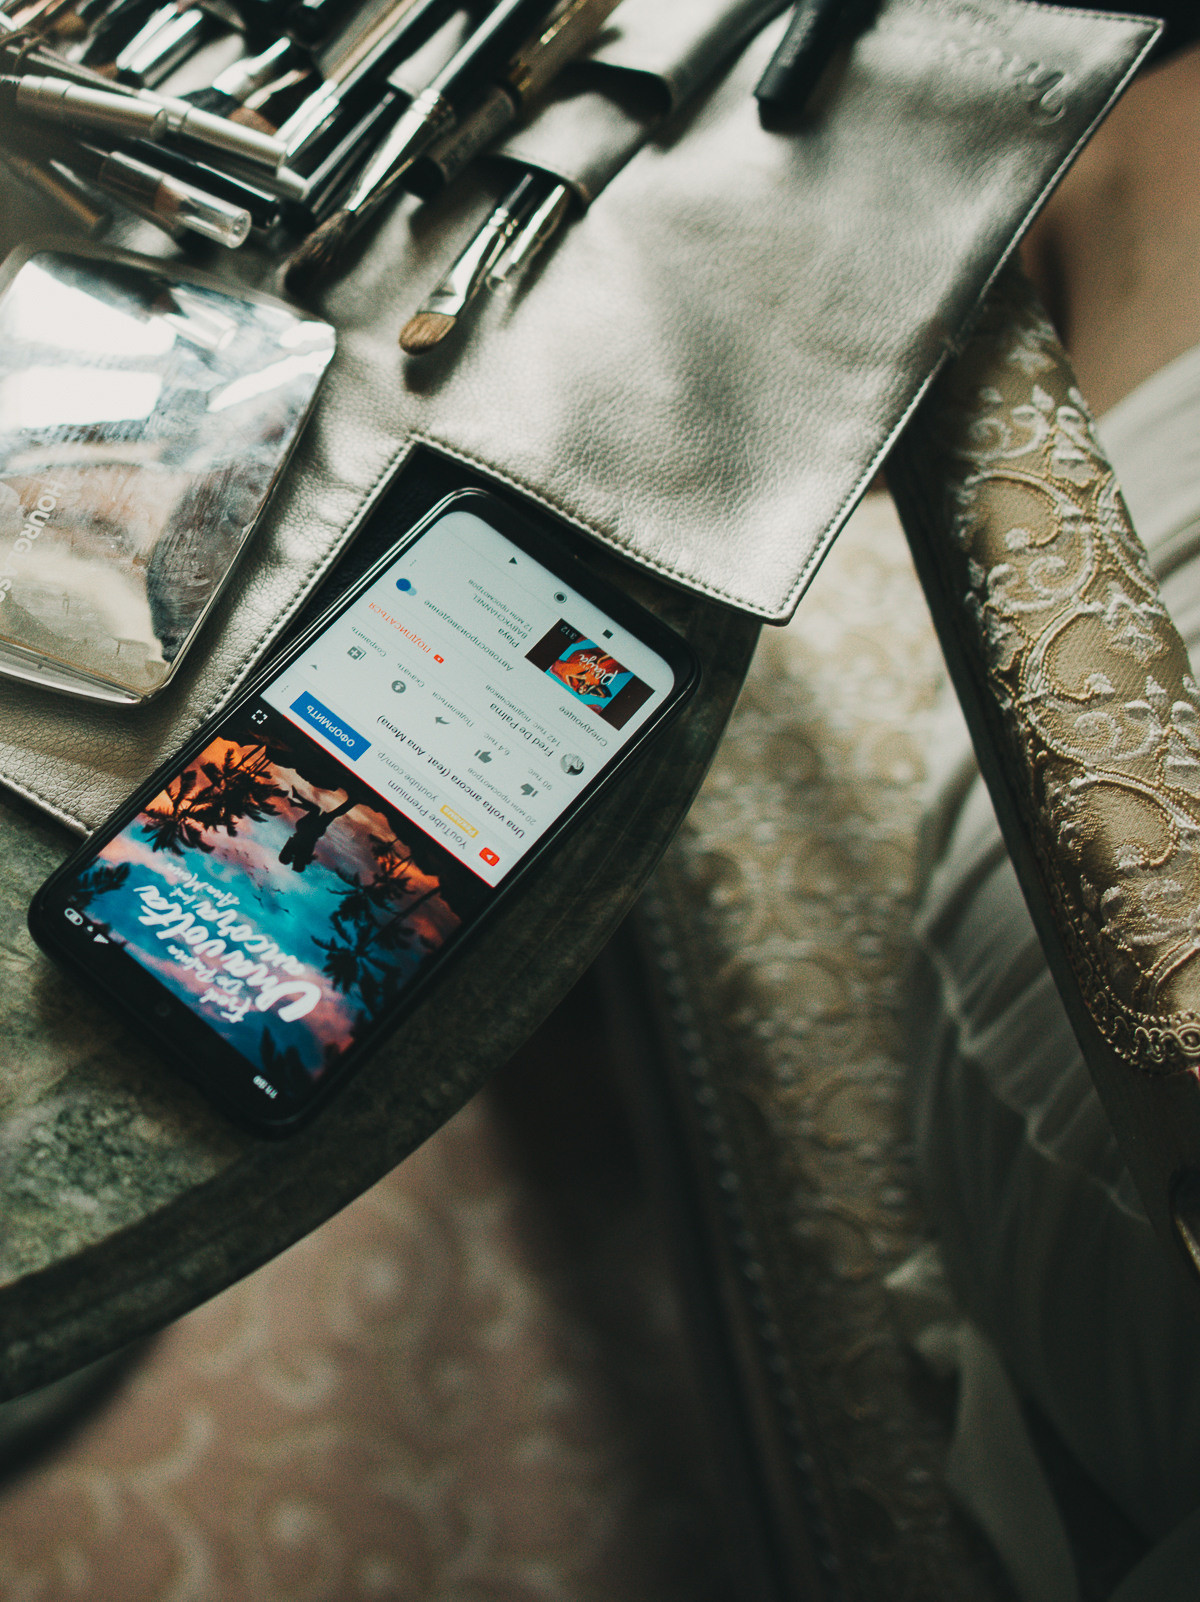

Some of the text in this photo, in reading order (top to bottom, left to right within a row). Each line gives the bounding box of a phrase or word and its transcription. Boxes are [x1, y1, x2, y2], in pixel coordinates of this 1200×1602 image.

[349, 626, 388, 657] Сохранить
[366, 602, 432, 652] ПОДПИСАТЬСЯ
[421, 600, 515, 672] Автовоспроизведение
[496, 627, 520, 647] Playa
[304, 704, 356, 747] ОФОРМИТЬ
[430, 690, 475, 728] Поделиться
[488, 702, 554, 756] Fred De Palma
[556, 705, 609, 746] Следующее
[376, 714, 526, 838] Una volta ancora (feat. Ana Mena)
[466, 766, 536, 826] 20 млн просмотров
[385, 779, 468, 850] YouTube Premium
[206, 884, 240, 908] Ana
[133, 885, 321, 1023] Una volta
[191, 900, 306, 976] ancora
[167, 945, 218, 985] Palma
[200, 987, 252, 1024] Fred
